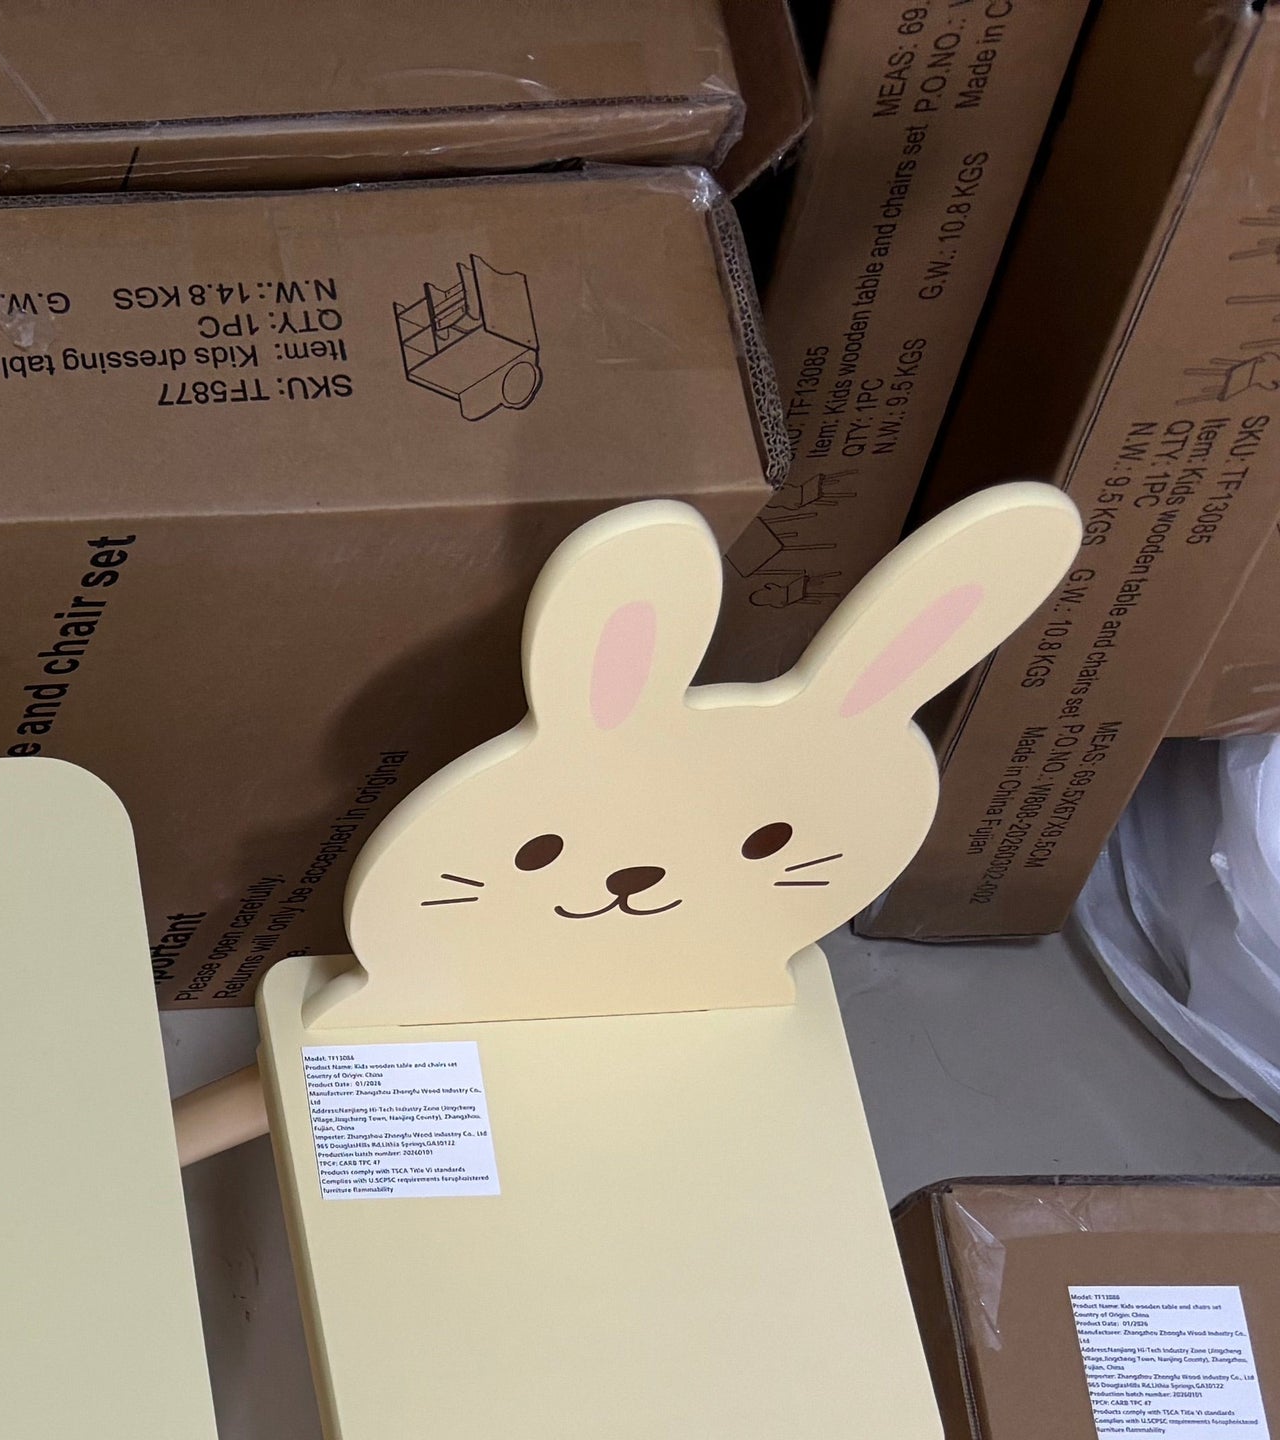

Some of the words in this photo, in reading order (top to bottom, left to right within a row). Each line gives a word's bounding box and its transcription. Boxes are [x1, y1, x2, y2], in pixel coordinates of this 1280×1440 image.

[903, 124, 929, 155] set
[880, 159, 916, 219] chairs
[871, 223, 897, 259] and
[852, 262, 884, 306] table
[198, 314, 260, 339] 1PC
[273, 309, 343, 332] QTY:
[63, 347, 187, 375] dressing
[196, 343, 259, 368] Kids
[278, 340, 347, 365] Item:
[839, 310, 872, 377] wooden
[894, 338, 926, 377] KGS
[158, 381, 268, 405] TF5877
[280, 374, 354, 401] SKU:
[786, 346, 829, 418] TF13085
[823, 379, 852, 415] Kids
[856, 378, 883, 412] 1PC
[887, 381, 913, 407] 9.5
[806, 418, 839, 458] Item:
[842, 417, 873, 457] QTY:
[872, 411, 906, 454] N.W.:
[1114, 422, 1158, 471] N.W.:
[1151, 420, 1195, 466] QTY:
[1188, 418, 1231, 463] Item:
[1225, 415, 1270, 463] SKU:
[1098, 477, 1130, 503] 9.5
[1134, 472, 1170, 508] 1PC
[1166, 468, 1203, 506] Kids
[1186, 467, 1249, 544] TF13085
[1082, 508, 1118, 546] KGS
[1129, 509, 1179, 575] wooden
[81, 535, 136, 587] set
[1054, 569, 1095, 612] G.W.:
[1109, 578, 1148, 616] table
[37, 596, 107, 674] chair
[1040, 620, 1072, 653] 10.8
[1093, 620, 1121, 648] and
[1021, 654, 1056, 688] KGS
[1071, 651, 1108, 695] chairs
[17, 683, 70, 735] and
[1058, 696, 1090, 719] set
[1010, 726, 1048, 765] Made
[1006, 766, 1022, 777] in
[986, 779, 1021, 816] China
[968, 819, 1001, 855] Fujian
[213, 954, 264, 999] Returns
[250, 934, 280, 954] will
[267, 905, 304, 933] only
[289, 887, 312, 906] be
[301, 824, 358, 885] accepted
[336, 806, 369, 823] in
[355, 750, 409, 804] original
[151, 912, 207, 984] portant
[175, 962, 221, 1001] Please
[208, 931, 241, 960] open
[230, 875, 285, 933] carefully.
